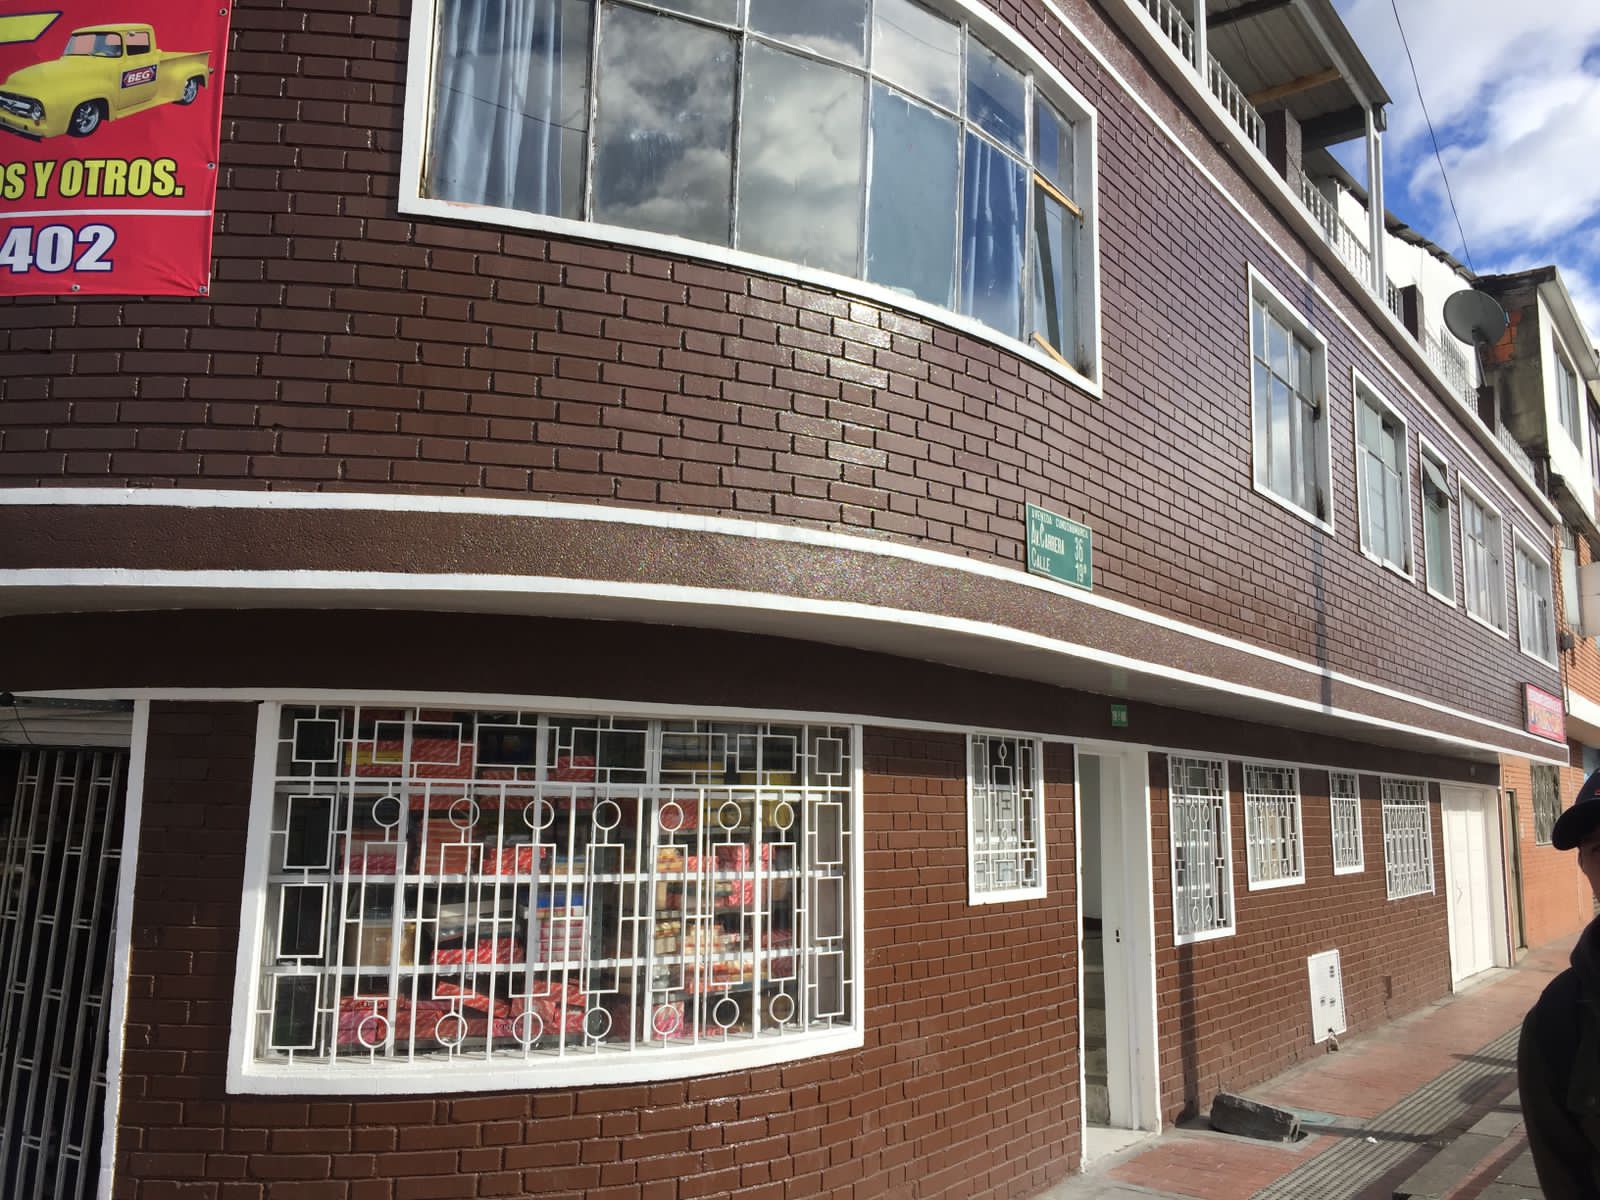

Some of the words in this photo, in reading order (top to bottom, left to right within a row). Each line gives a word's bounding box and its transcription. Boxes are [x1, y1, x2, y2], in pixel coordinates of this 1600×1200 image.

[127, 70, 150, 83] BEG
[33, 160, 56, 198] Y
[58, 157, 185, 198] OTROS.
[0, 224, 117, 273] 402
